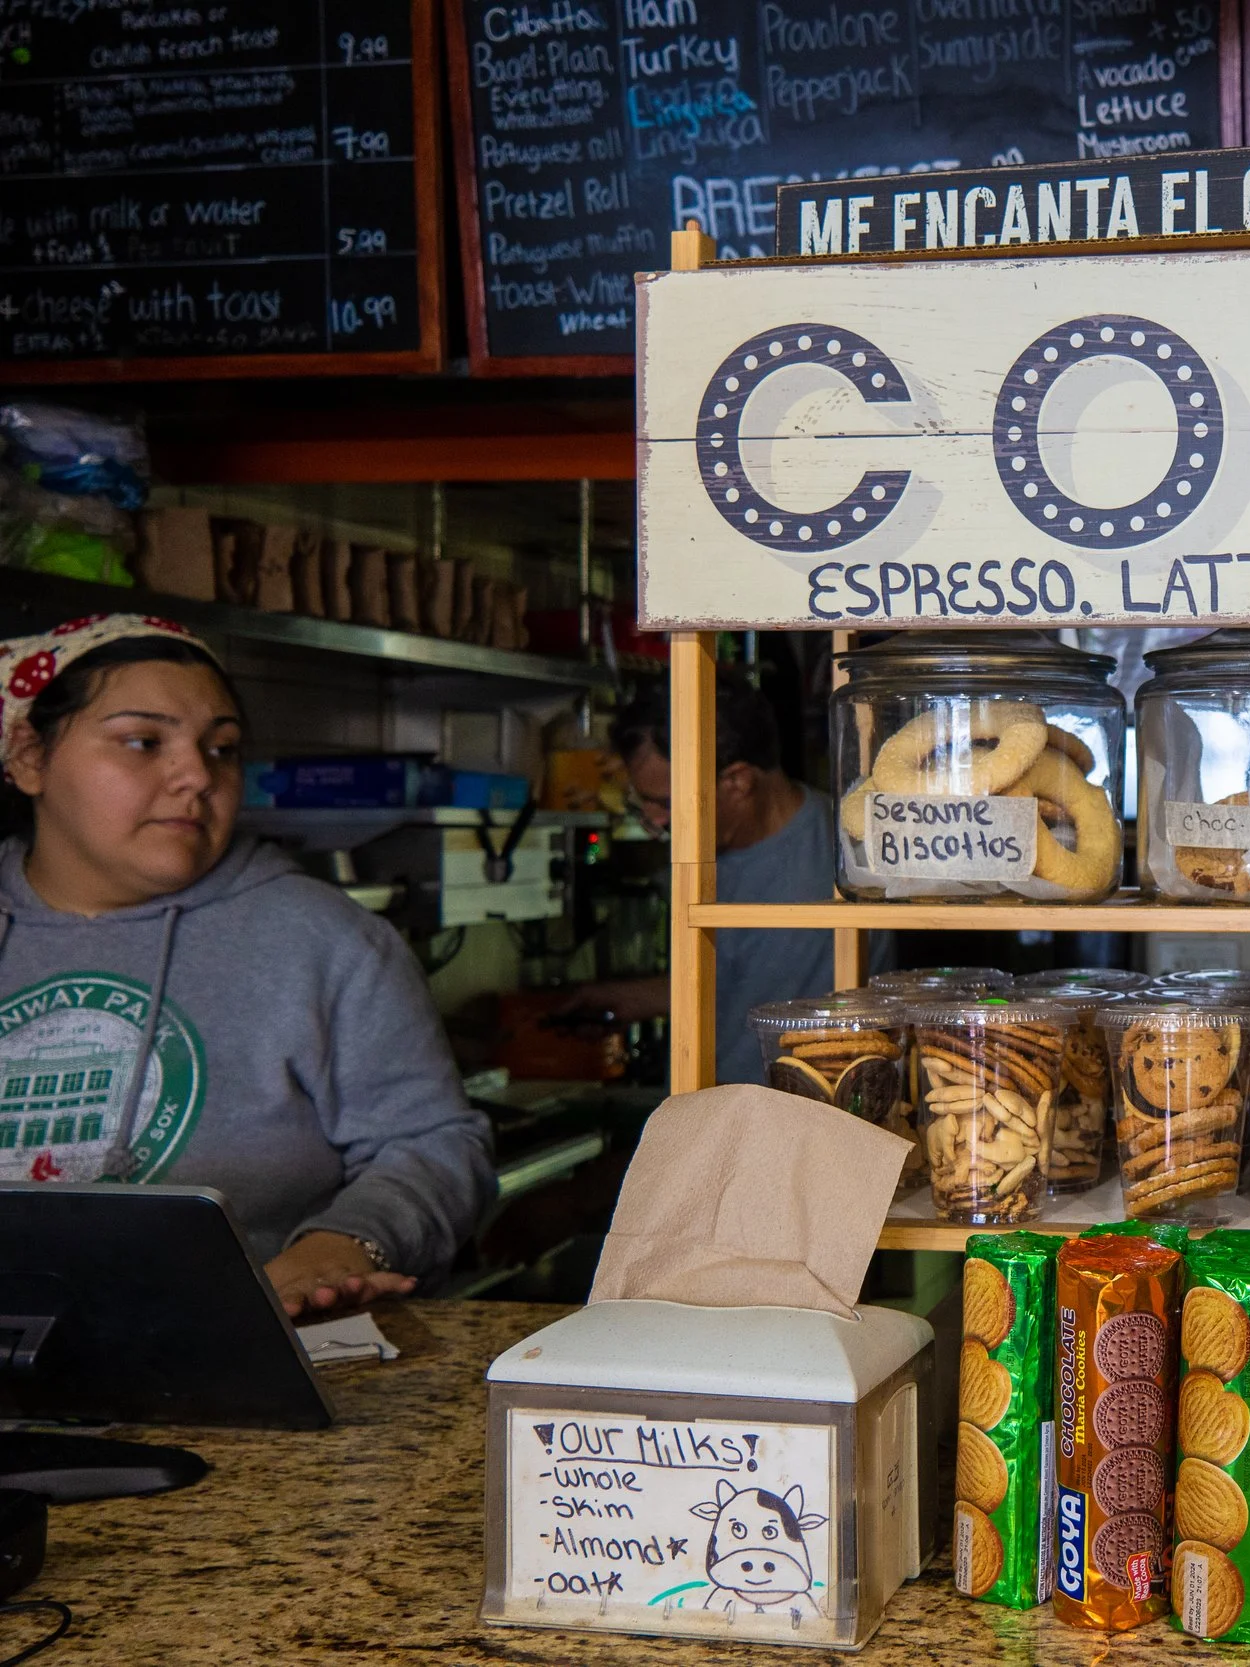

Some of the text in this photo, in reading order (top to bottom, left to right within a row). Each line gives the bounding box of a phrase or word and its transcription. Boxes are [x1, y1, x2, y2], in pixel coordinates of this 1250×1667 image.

[625, 0, 698, 29] Ham
[762, 4, 900, 54] Provolone
[339, 32, 389, 67] 9.99
[1077, 53, 1175, 90] Avocado
[1078, 91, 1189, 128] Lettuce
[333, 126, 390, 160] 7.99
[1077, 131, 1191, 159] Mushroom
[89, 193, 142, 232] milk
[184, 197, 268, 227] water
[484, 178, 575, 222] Pretzel
[586, 172, 631, 215] Roll
[893, 175, 1140, 250] ENCANTA
[1162, 169, 1223, 235] EL
[128, 279, 197, 325] with
[205, 278, 281, 322] toast
[331, 294, 398, 336] 10.99
[872, 794, 994, 825] Sesame
[103, 990, 176, 1050] PAK
[150, 1100, 180, 1142] SOX
[1076, 1330, 1086, 1391] Cookies
[1061, 1306, 1076, 1458] CHOCOLATE
[1061, 1494, 1081, 1592] GOYA
[1134, 1571, 1142, 1599] Made
